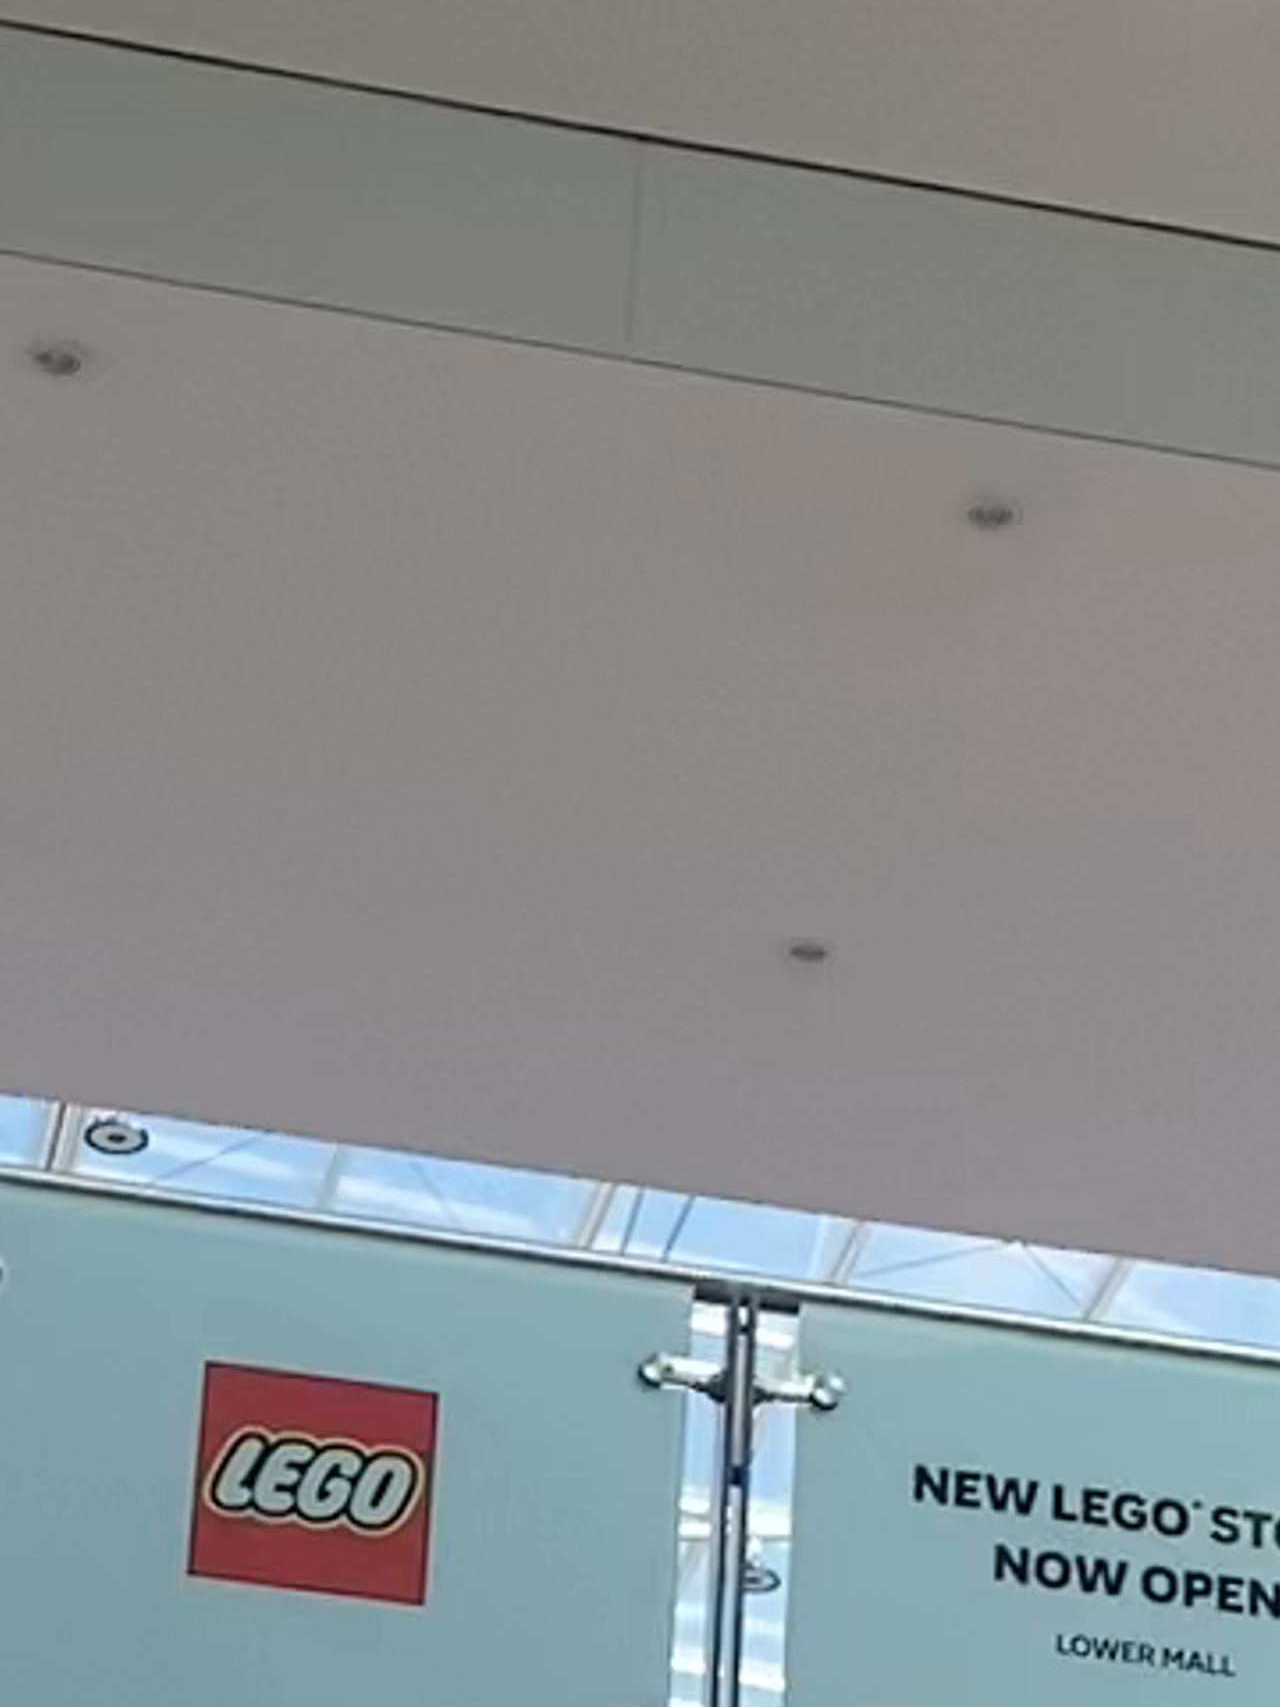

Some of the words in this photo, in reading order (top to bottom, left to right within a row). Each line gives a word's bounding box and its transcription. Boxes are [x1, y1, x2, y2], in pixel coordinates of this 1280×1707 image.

[212, 1432, 420, 1532] LEGO
[912, 1463, 1039, 1517] NEW
[993, 1543, 1129, 1598] NOW
[1055, 1633, 1156, 1667] LOWER
[1161, 1646, 1236, 1678] MALL
